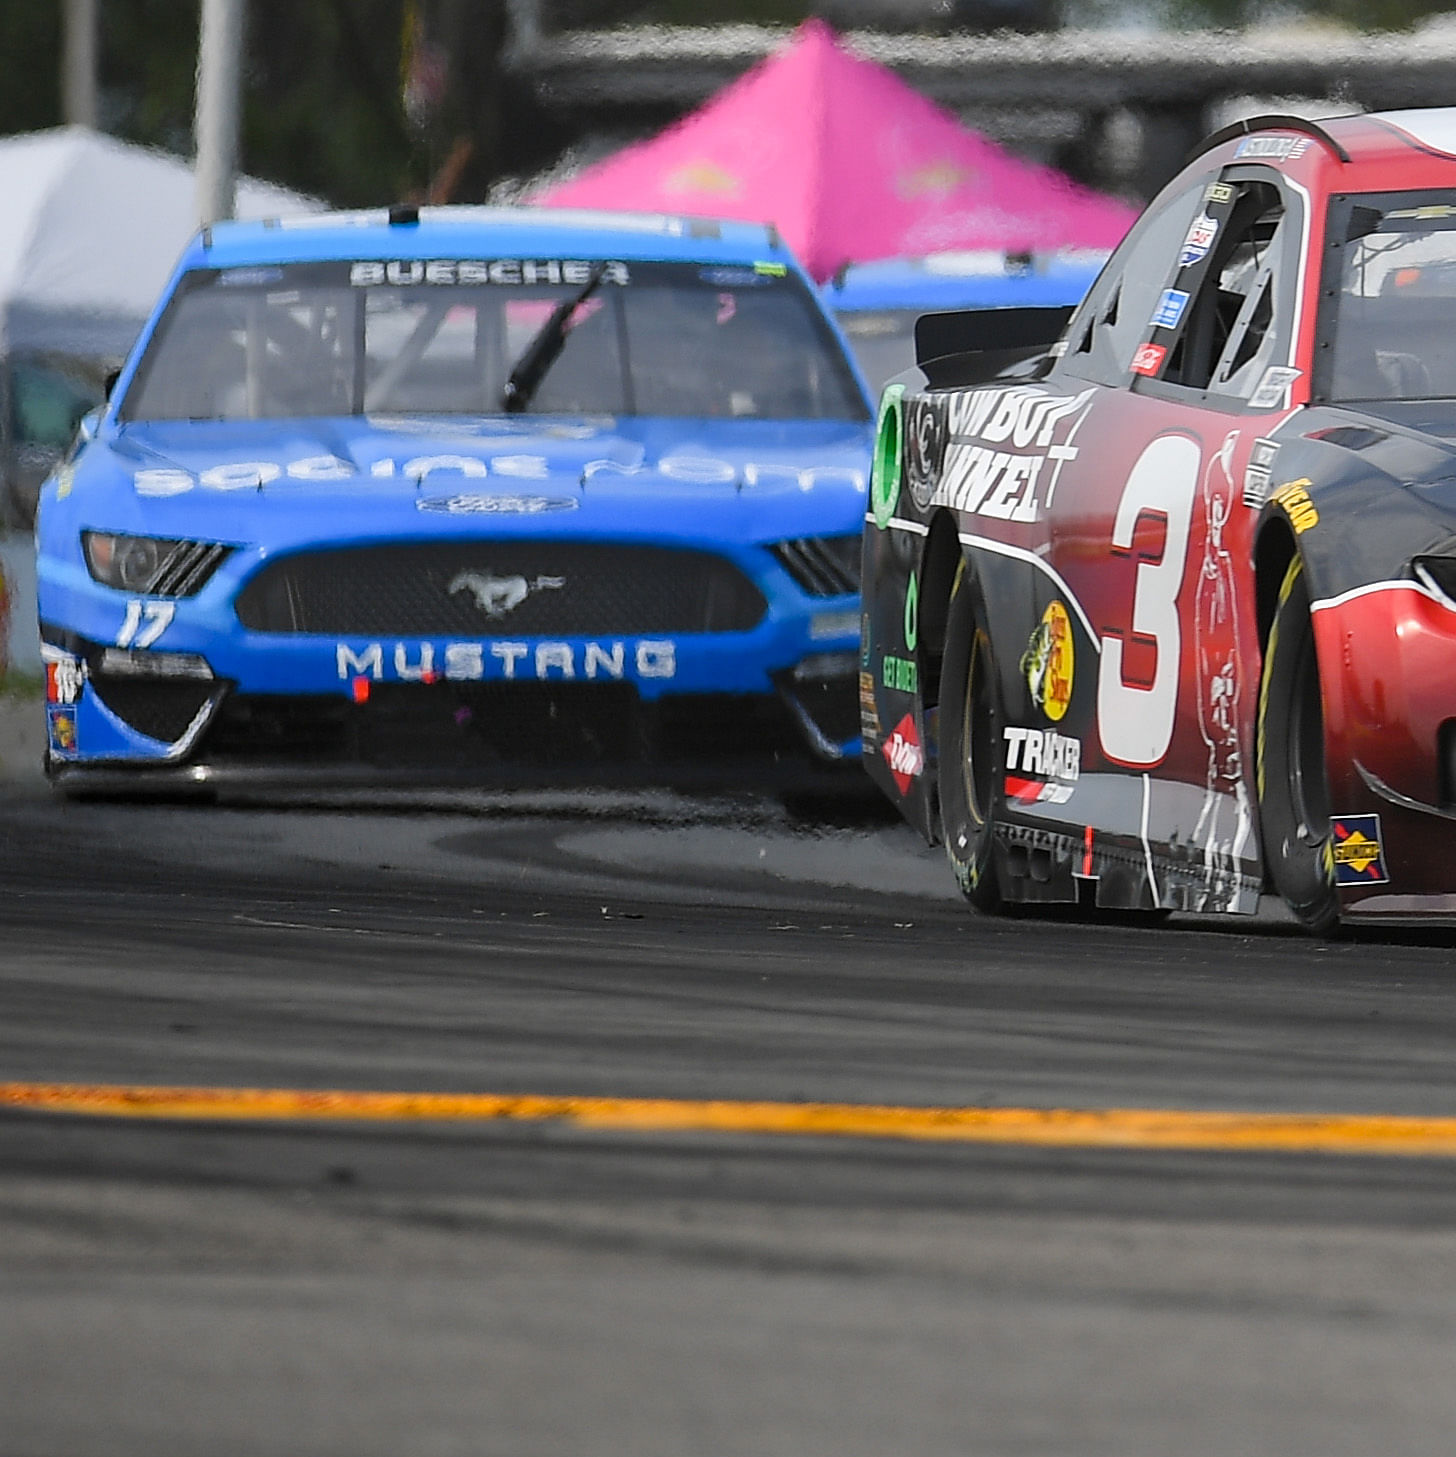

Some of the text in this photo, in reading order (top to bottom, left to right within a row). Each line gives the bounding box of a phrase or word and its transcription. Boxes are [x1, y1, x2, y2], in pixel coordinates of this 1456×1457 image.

[115, 599, 176, 648] 17
[1097, 433, 1202, 766] 3
[336, 640, 677, 681] MUSTANG
